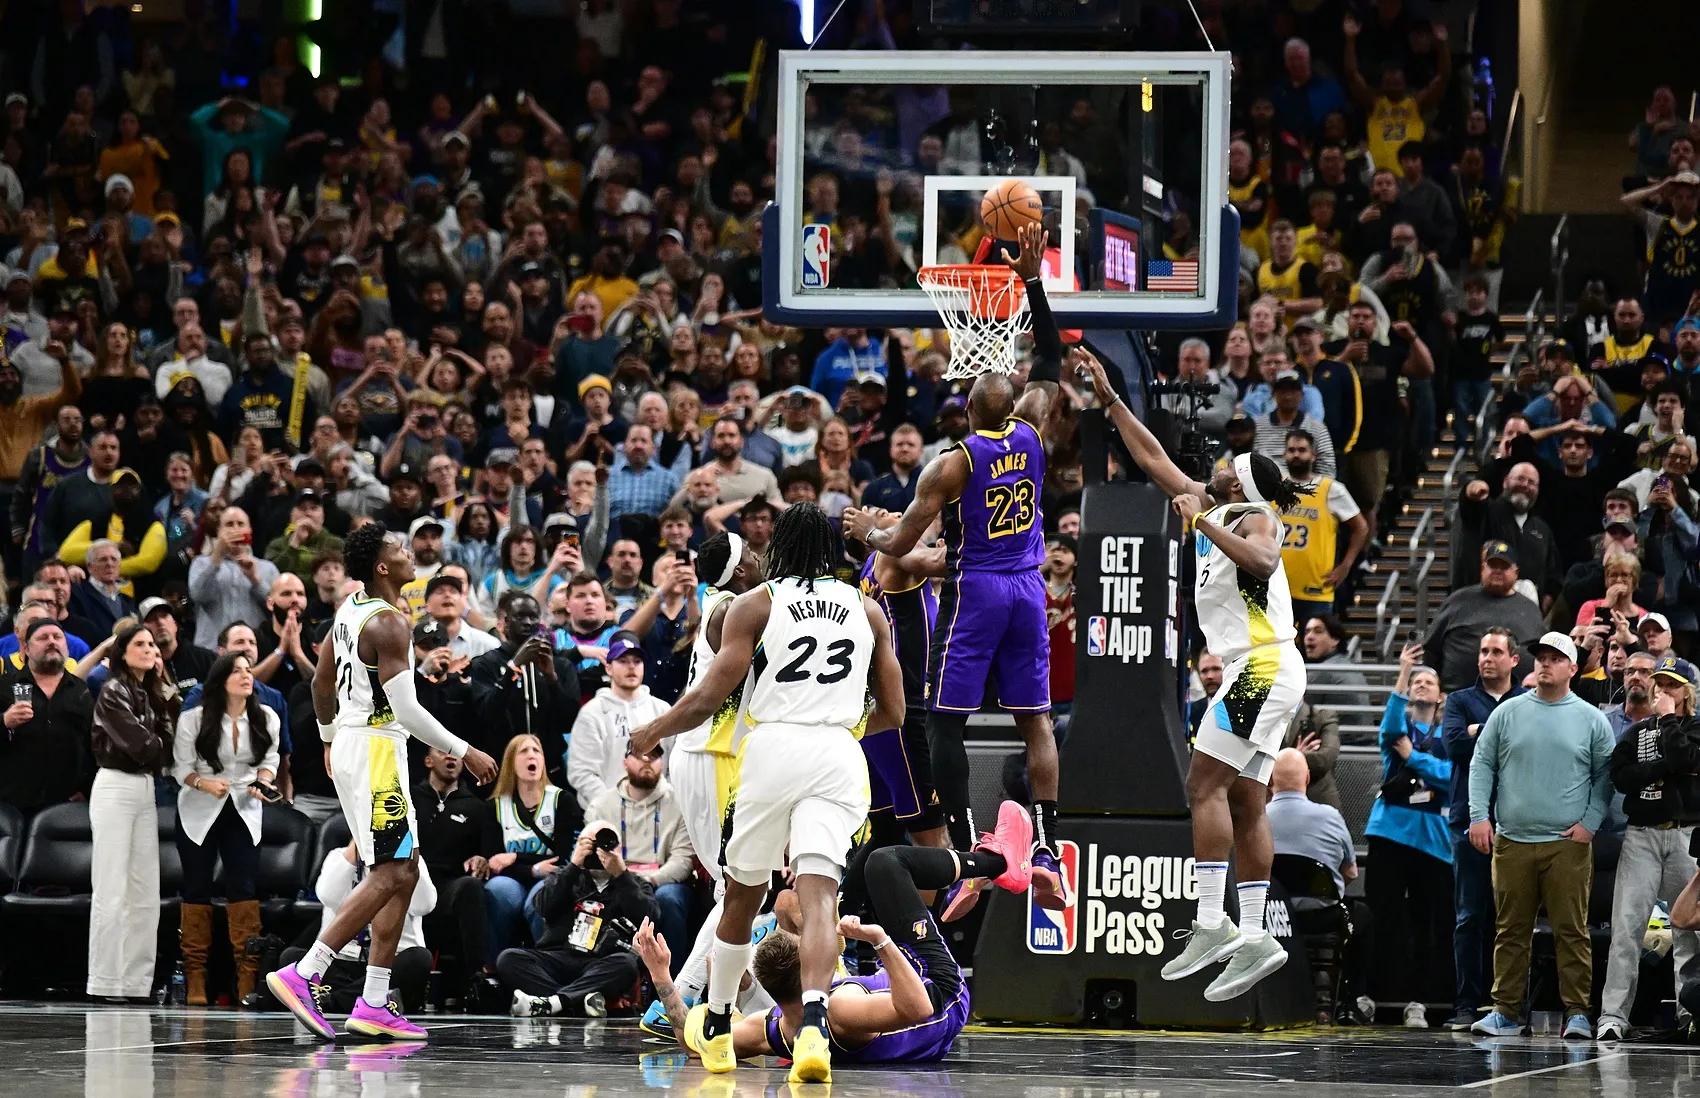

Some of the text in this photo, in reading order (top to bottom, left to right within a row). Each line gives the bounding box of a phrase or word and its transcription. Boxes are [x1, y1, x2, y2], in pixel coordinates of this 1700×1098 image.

[805, 273, 818, 284] NBA
[990, 452, 1027, 479] JAMES
[986, 478, 1035, 540] 23
[1282, 523, 1308, 548] 23
[1100, 536, 1144, 573] GET
[787, 600, 849, 626] NESMITH
[1099, 576, 1144, 613] THE
[1107, 617, 1152, 663] App
[775, 635, 855, 684] 23
[1087, 844, 1199, 909] League
[1034, 928, 1058, 946] NBA
[1085, 899, 1165, 955] Pass
